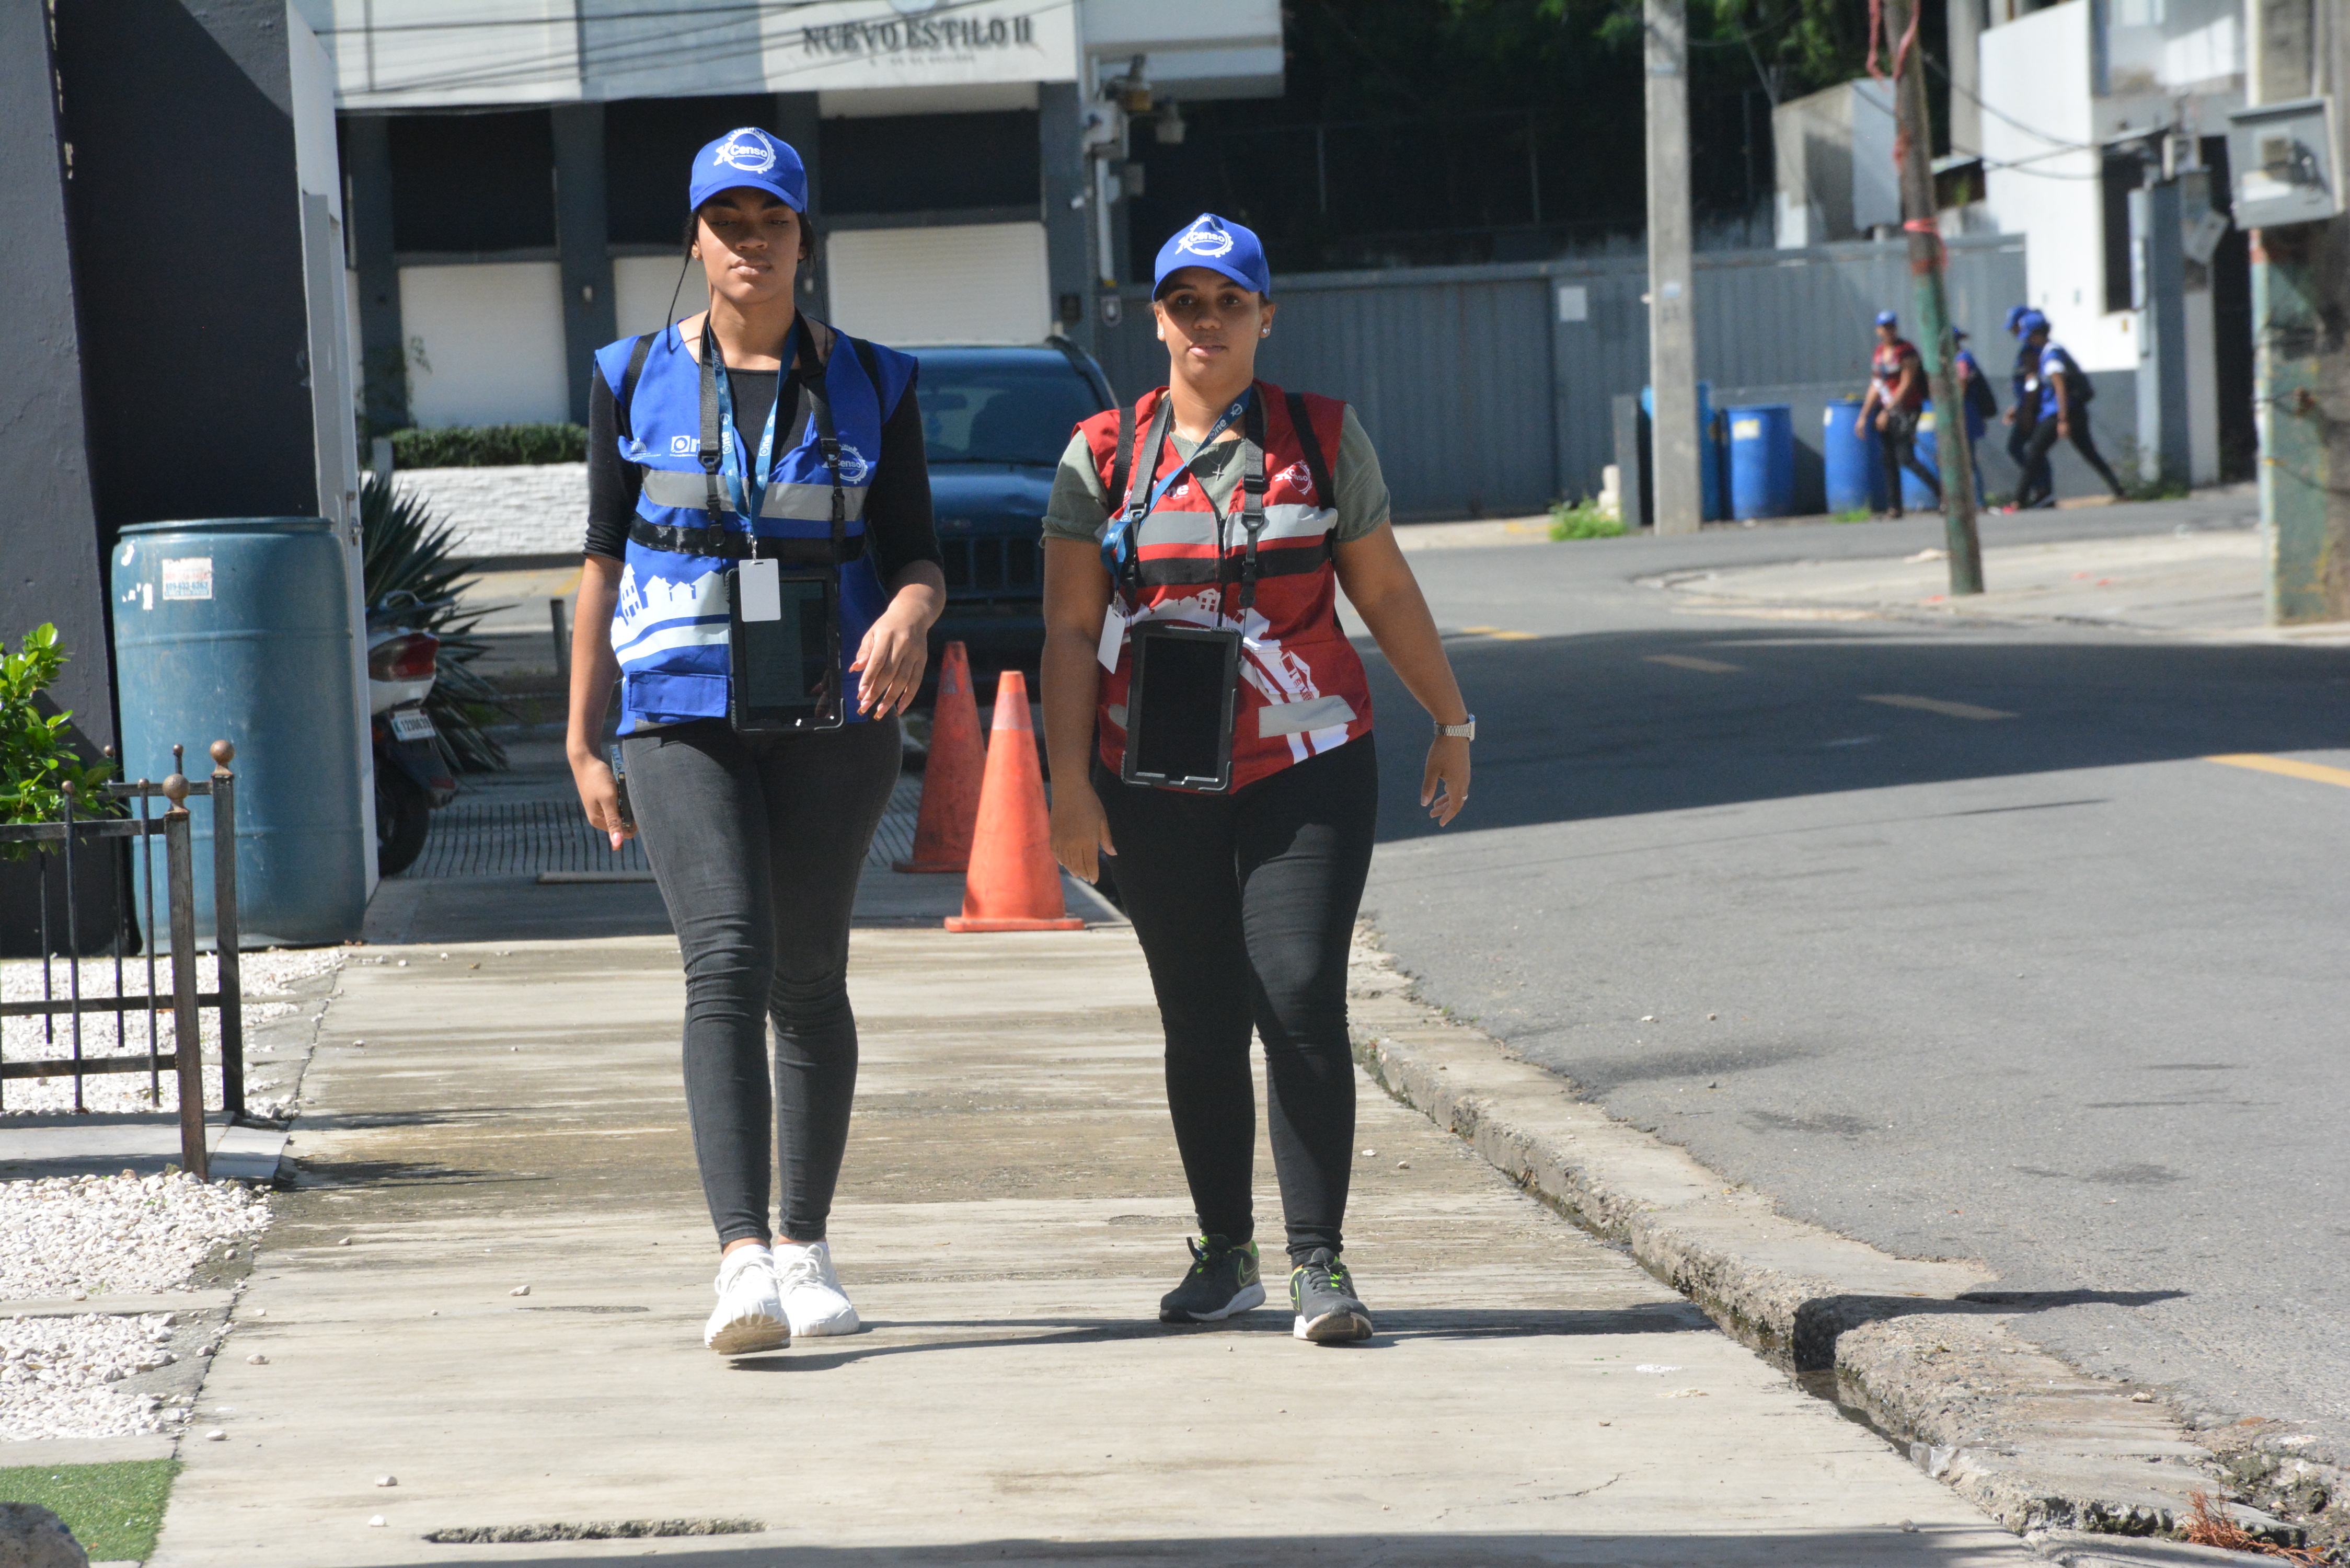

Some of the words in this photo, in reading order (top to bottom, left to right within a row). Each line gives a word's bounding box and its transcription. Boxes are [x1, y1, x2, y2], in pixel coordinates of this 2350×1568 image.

[802, 22, 897, 52] NUEVO
[906, 18, 1007, 49] ESTILO
[1013, 16, 1033, 43] II
[730, 144, 768, 157] Censo
[1190, 232, 1225, 242] Censo
[838, 460, 861, 468] enso
